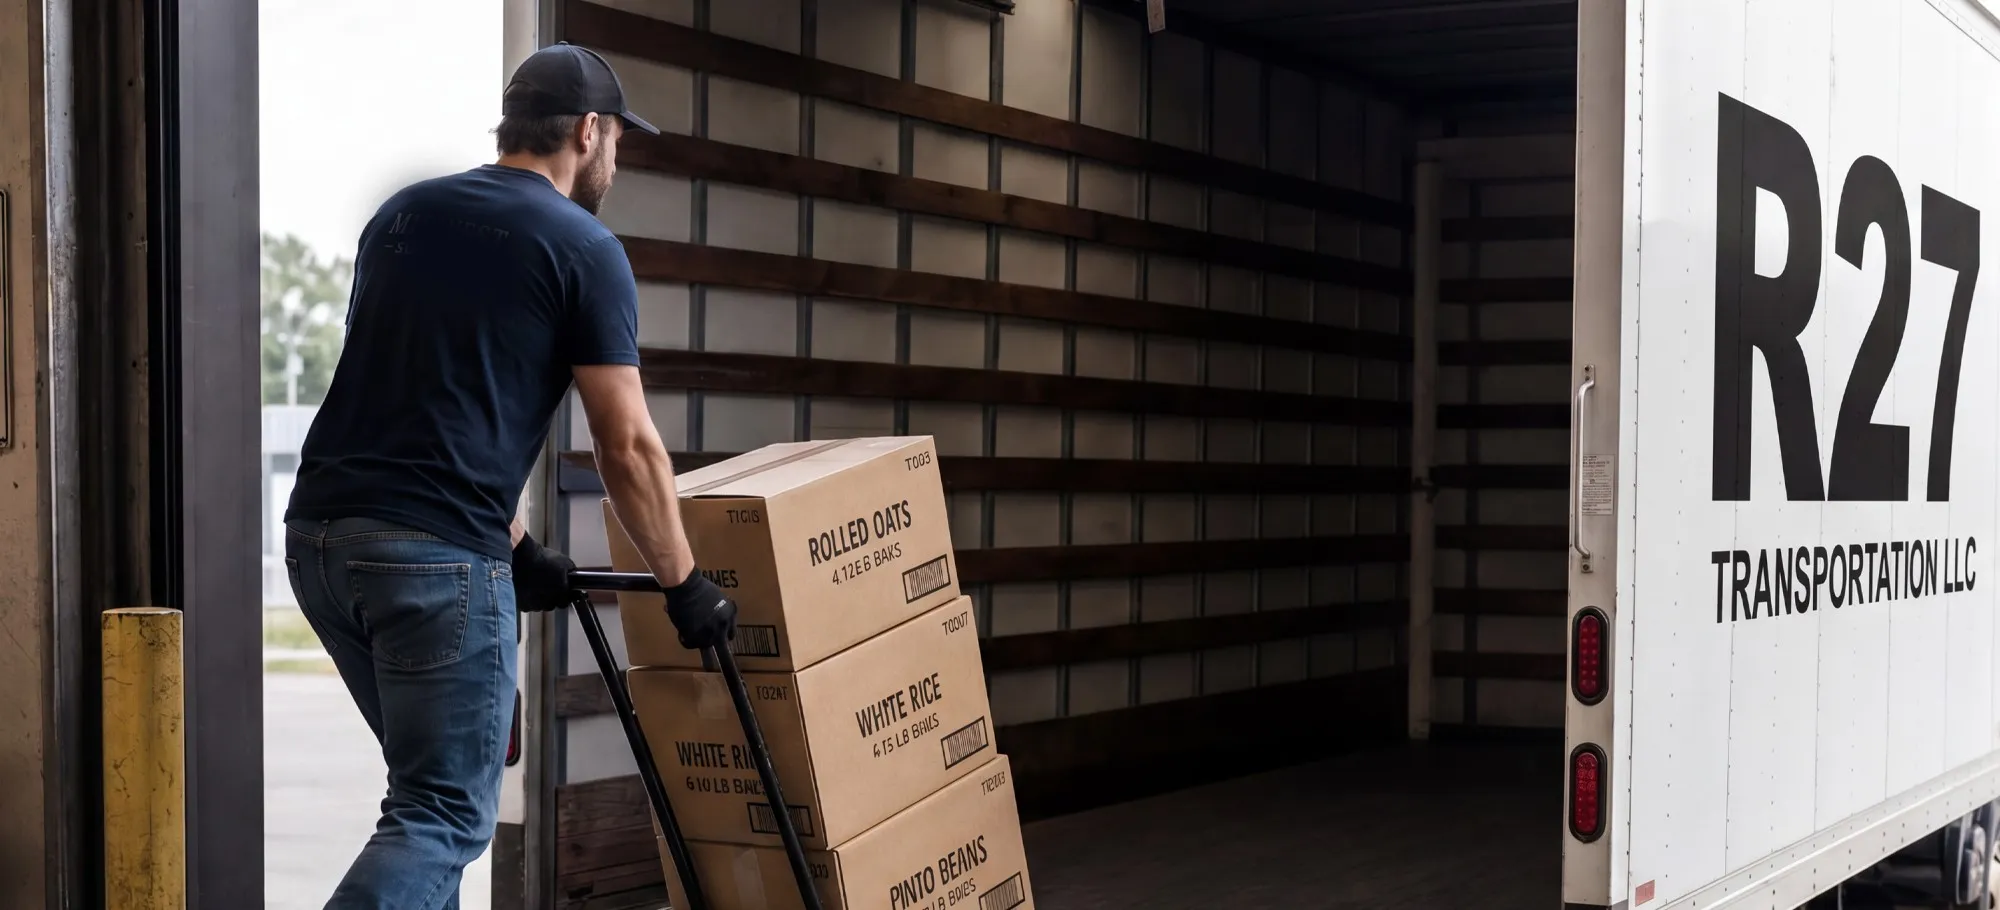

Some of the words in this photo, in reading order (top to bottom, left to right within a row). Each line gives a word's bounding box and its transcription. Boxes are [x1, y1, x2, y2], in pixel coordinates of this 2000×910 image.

[1711, 91, 1981, 502] R27
[808, 517, 869, 567] ROLLED
[873, 500, 912, 539] OATS
[1711, 539, 1938, 623] TRANSPORTATION
[1943, 536, 1977, 594] LLC
[855, 690, 908, 738] WHITE
[908, 672, 942, 712] RICE
[896, 728, 910, 747] LB
[675, 741, 729, 768] WHITE
[714, 778, 730, 794] LB
[890, 866, 935, 910] PINTO
[938, 834, 988, 886] BEANS
